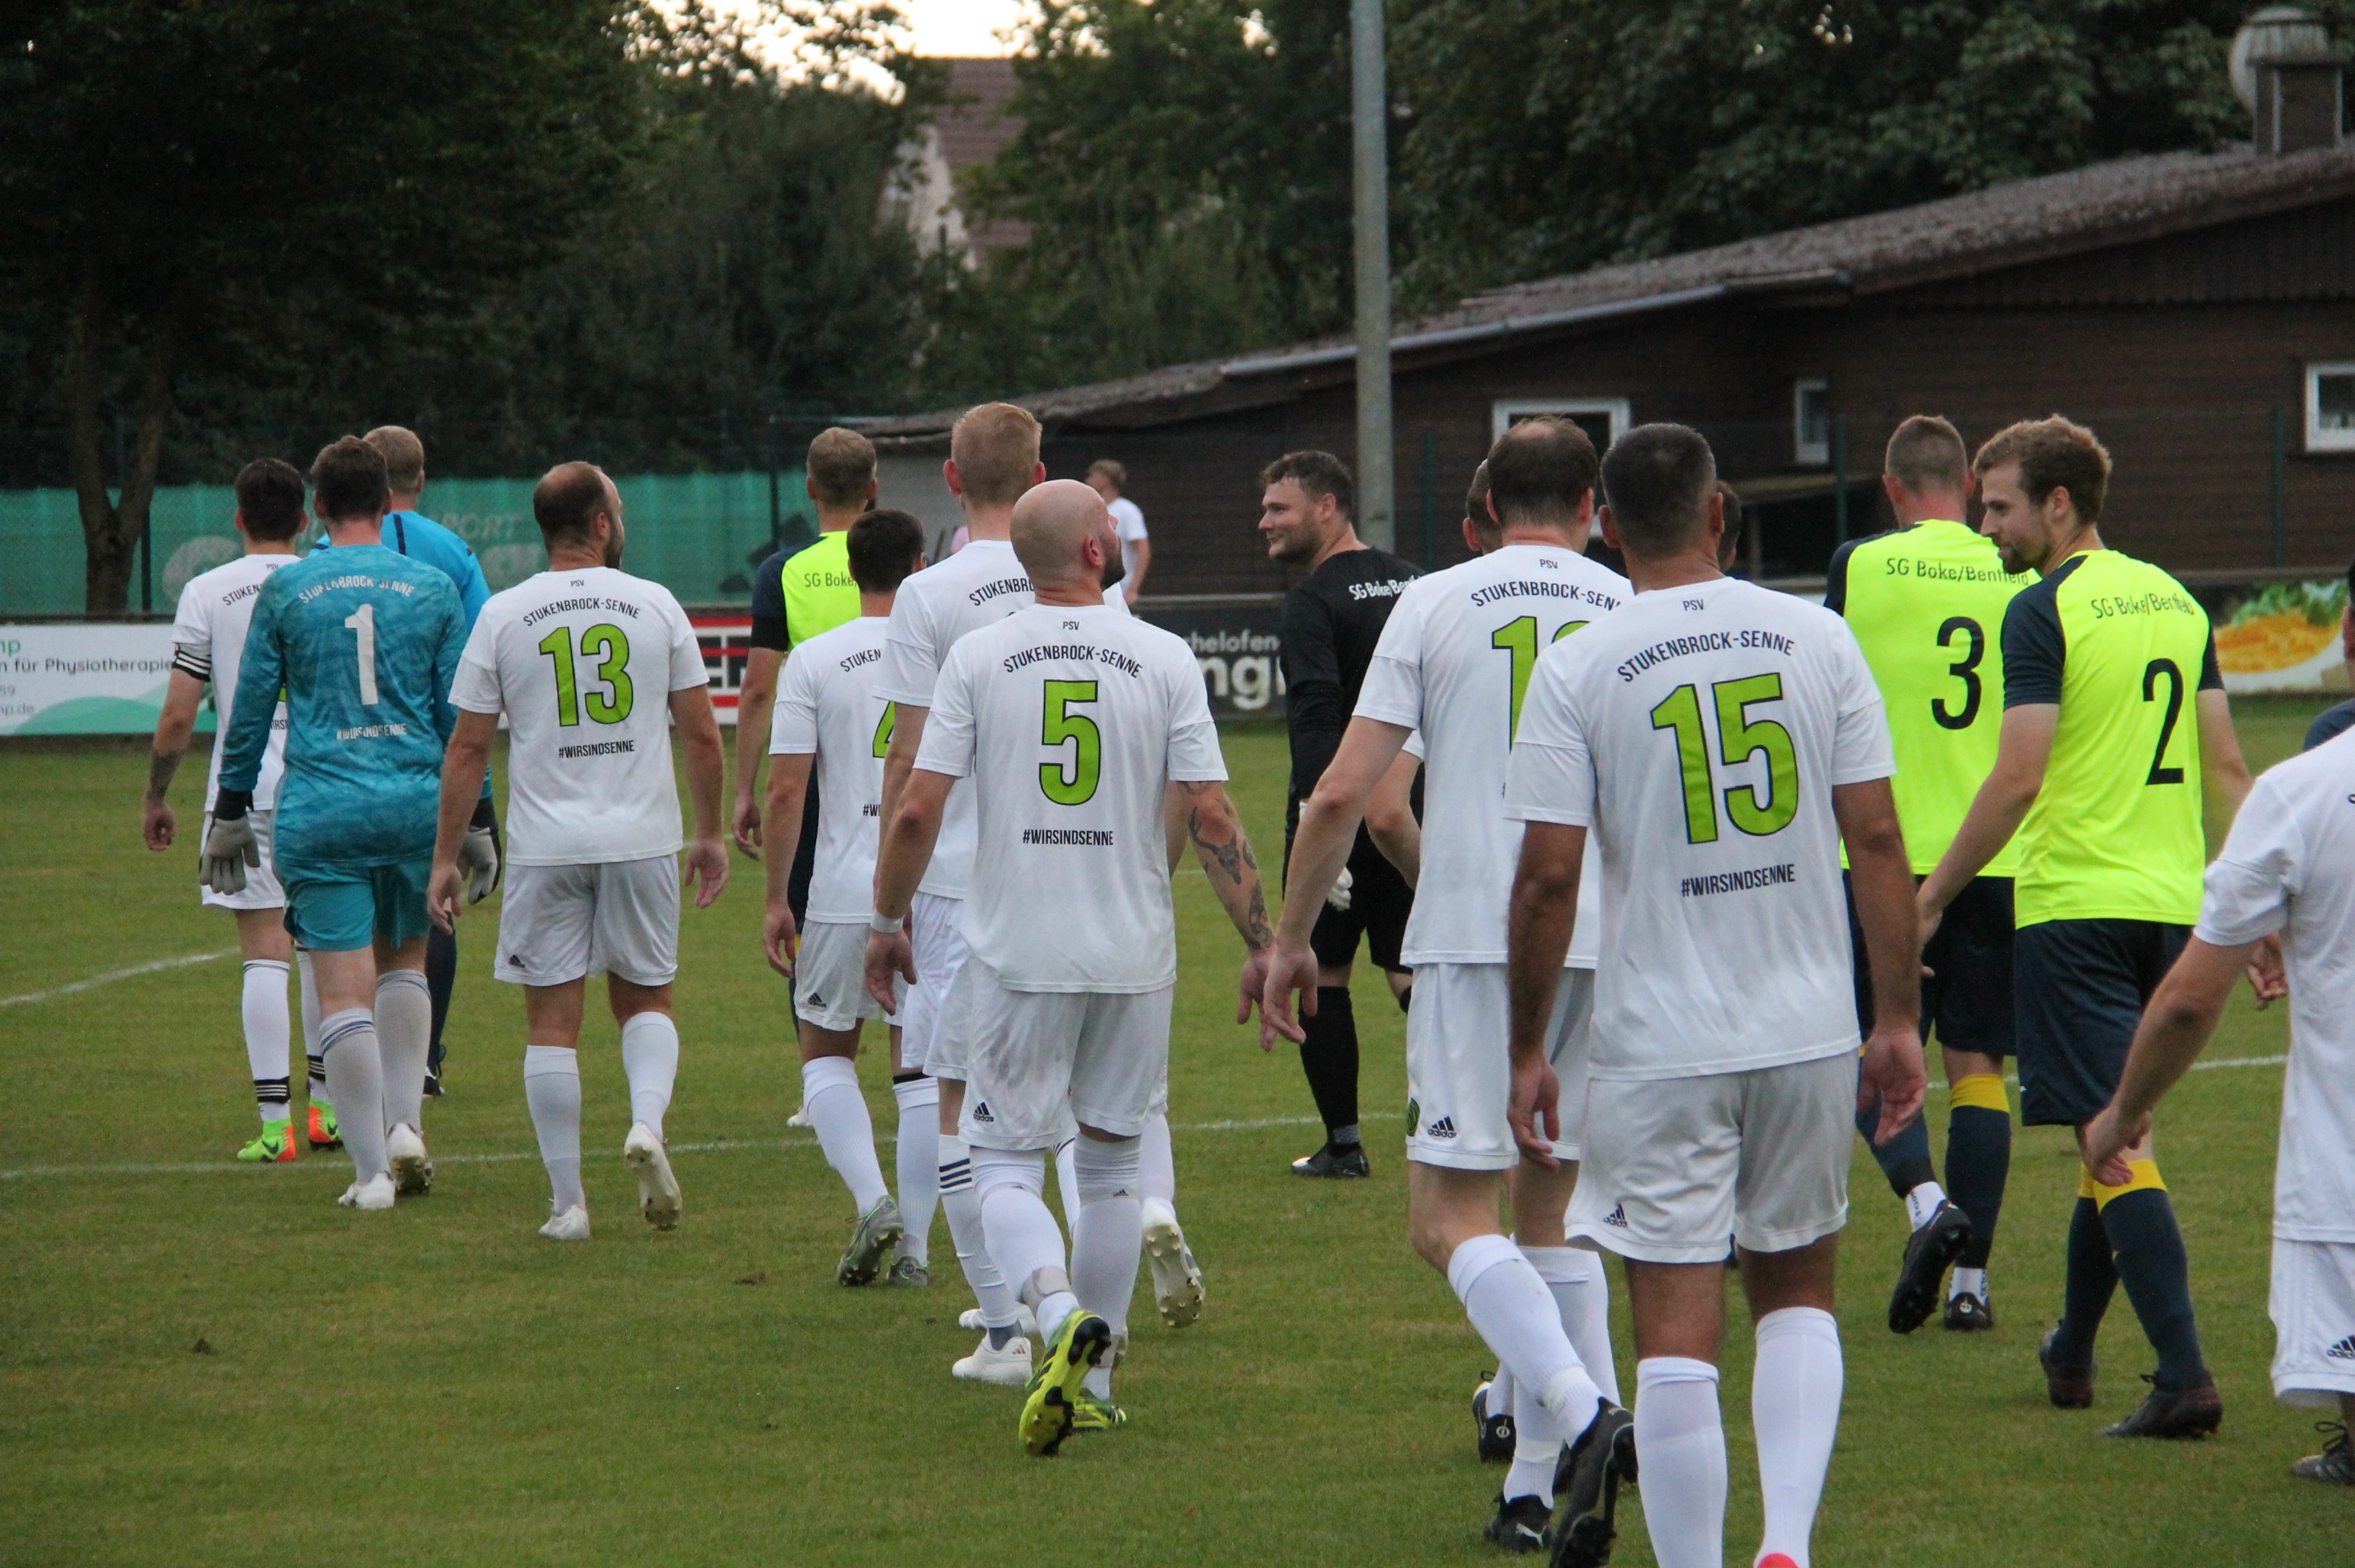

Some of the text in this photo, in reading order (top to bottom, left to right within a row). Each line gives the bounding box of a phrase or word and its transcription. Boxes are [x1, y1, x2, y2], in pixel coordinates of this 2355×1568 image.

[1540, 558, 1559, 569] PSV
[1886, 557, 1909, 575] SG
[805, 573, 821, 587] SG
[1348, 583, 1367, 600] SG
[523, 597, 641, 627] STUKENBROCK-SENNE
[1683, 599, 1704, 612] PSV
[2091, 598, 2114, 619] SG
[1063, 622, 1079, 631] PSV
[14, 657, 37, 673] für
[45, 657, 172, 675] Physiotherapie
[345, 603, 379, 705] 1
[1004, 645, 1143, 678] STUKENBROCK-SENNE
[1618, 631, 1794, 683] STUKENBROCK-SENNE
[538, 623, 634, 727] 13
[1492, 615, 1592, 755] 1
[1931, 616, 1983, 730] 3
[2142, 658, 2184, 785] 2
[558, 741, 635, 758] #WIRSINDSENNE
[1039, 680, 1101, 806] 5
[1650, 672, 1798, 844] 15
[1023, 829, 1113, 846] #WIRSINDSENNE
[1681, 864, 1795, 897] #WIRSINDSENNE
